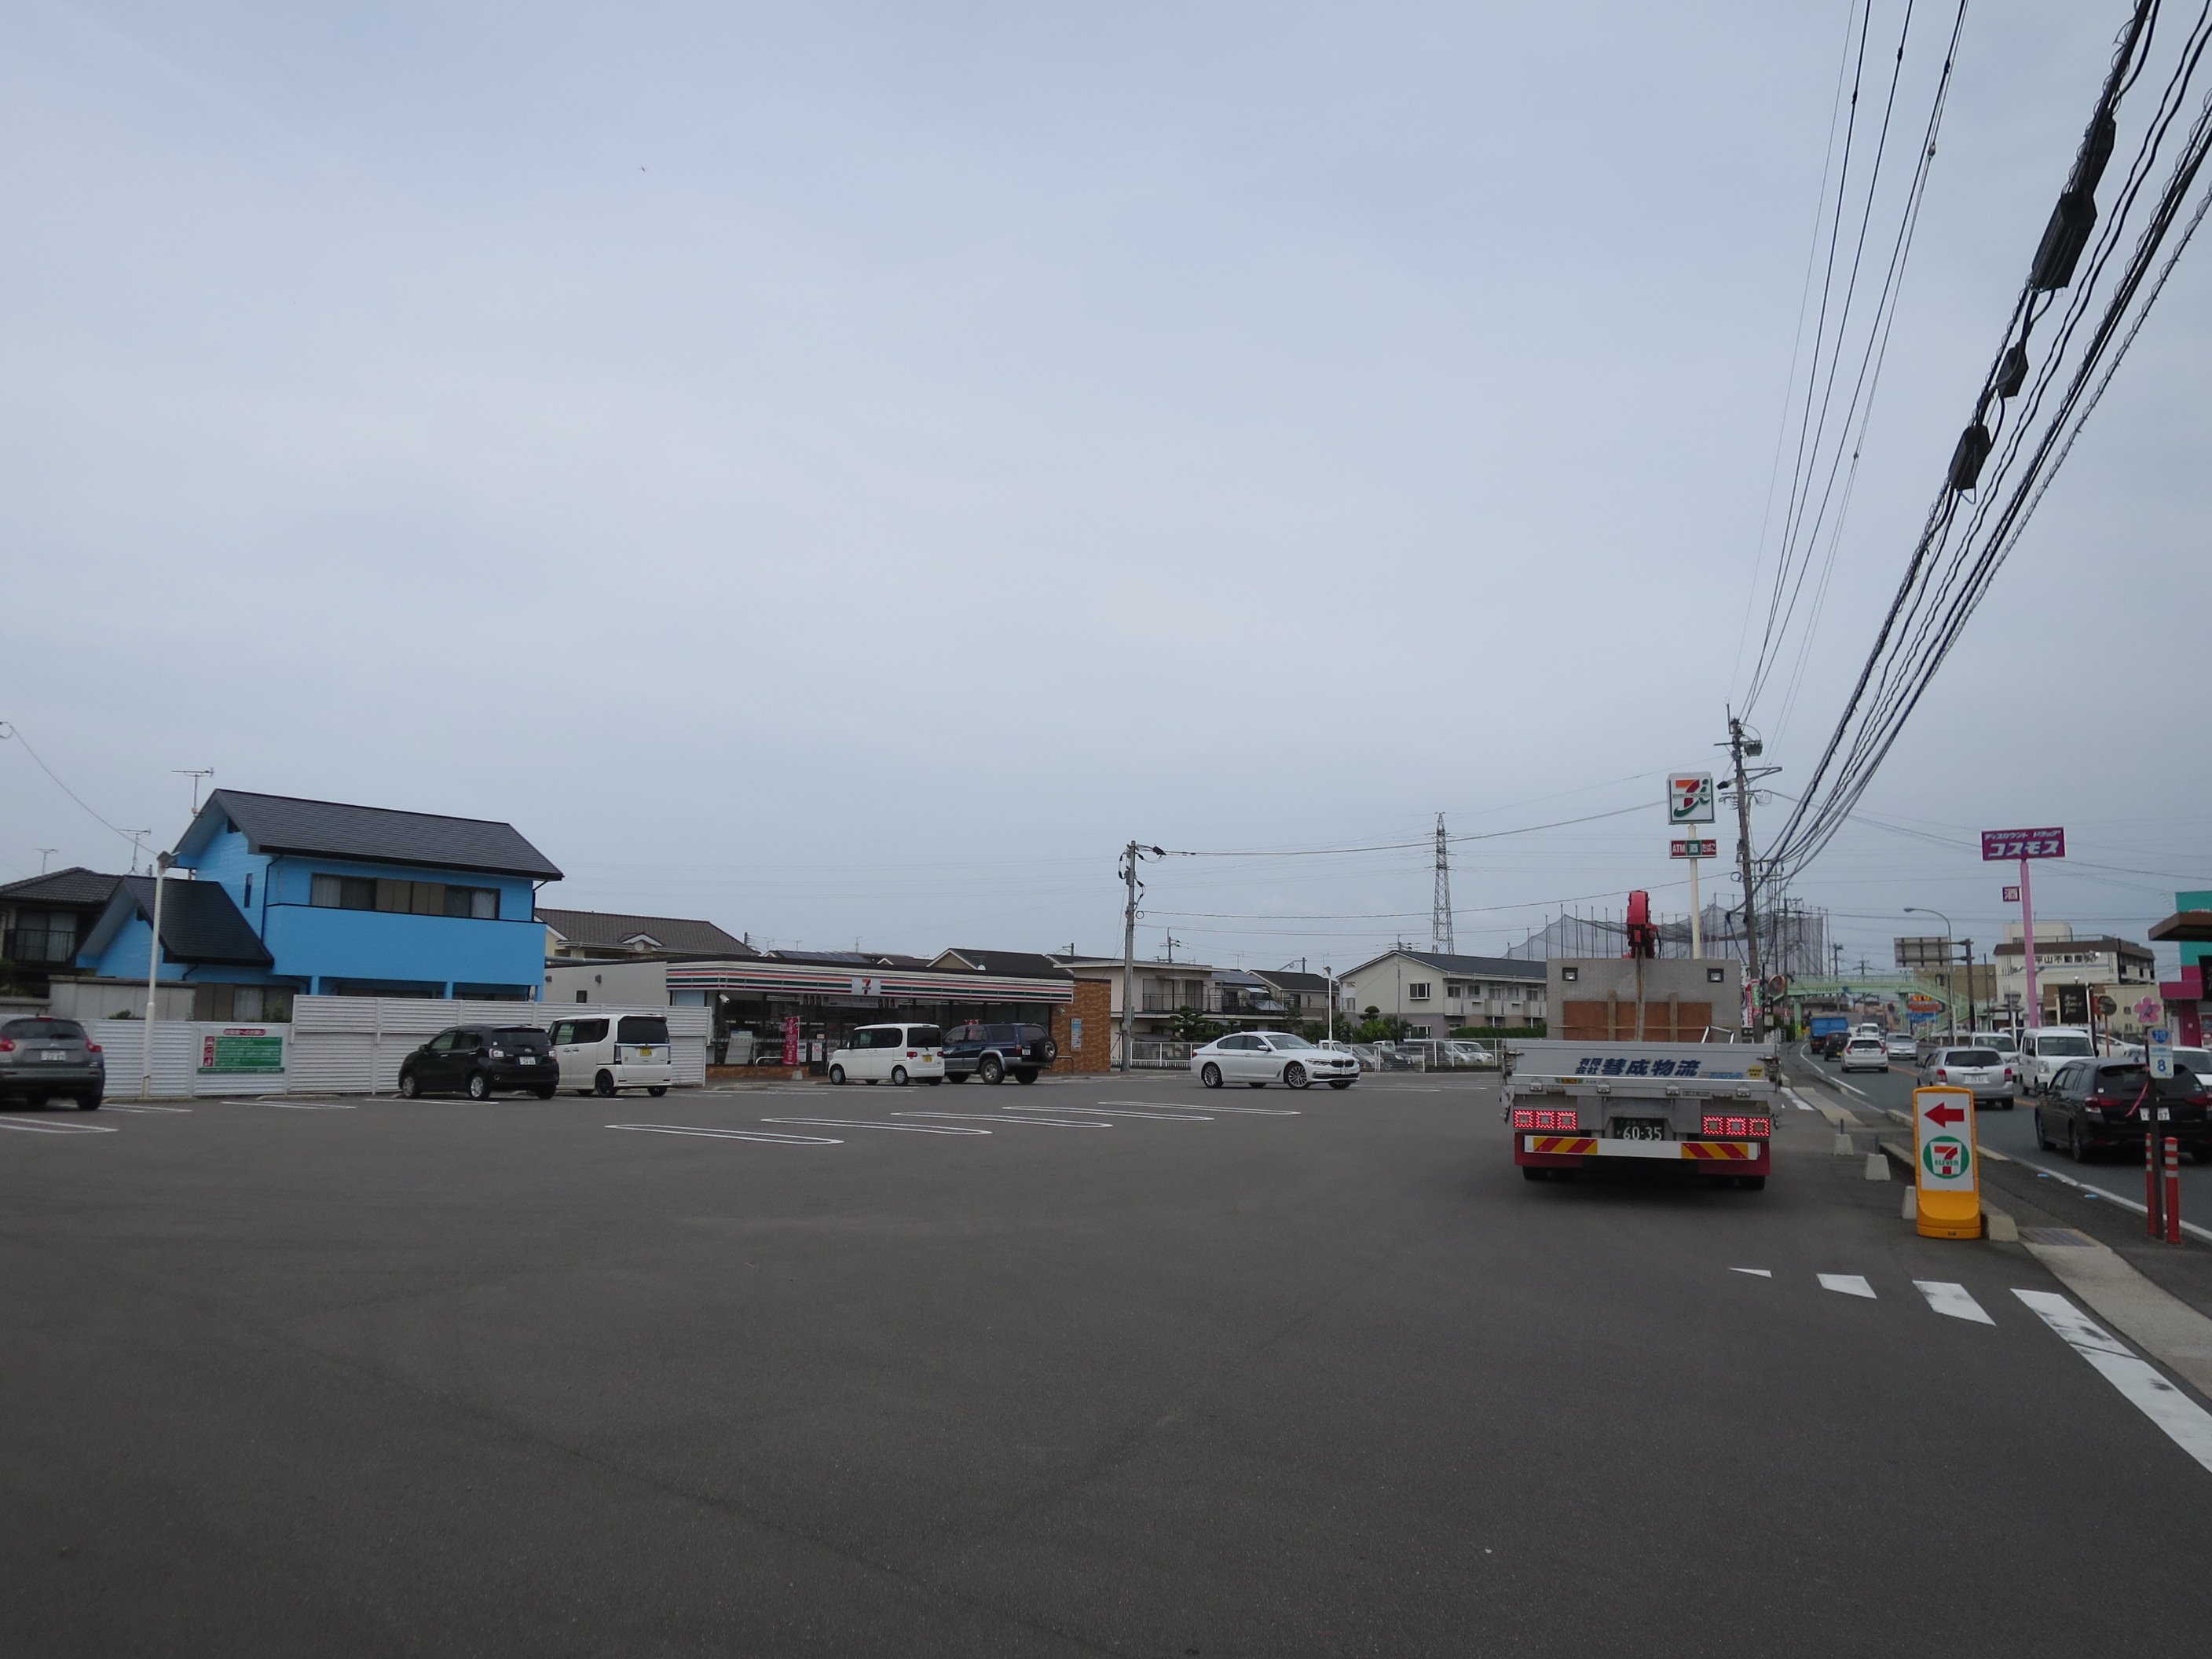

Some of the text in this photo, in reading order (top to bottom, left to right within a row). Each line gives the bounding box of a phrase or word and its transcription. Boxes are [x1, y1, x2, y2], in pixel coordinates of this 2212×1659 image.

[1672, 844, 1686, 853] ATM
[1988, 840, 2060, 857] コスモス
[2004, 888, 2018, 899] 酒
[2157, 1059, 2166, 1072] 8
[1623, 1126, 1662, 1141] 60-35
